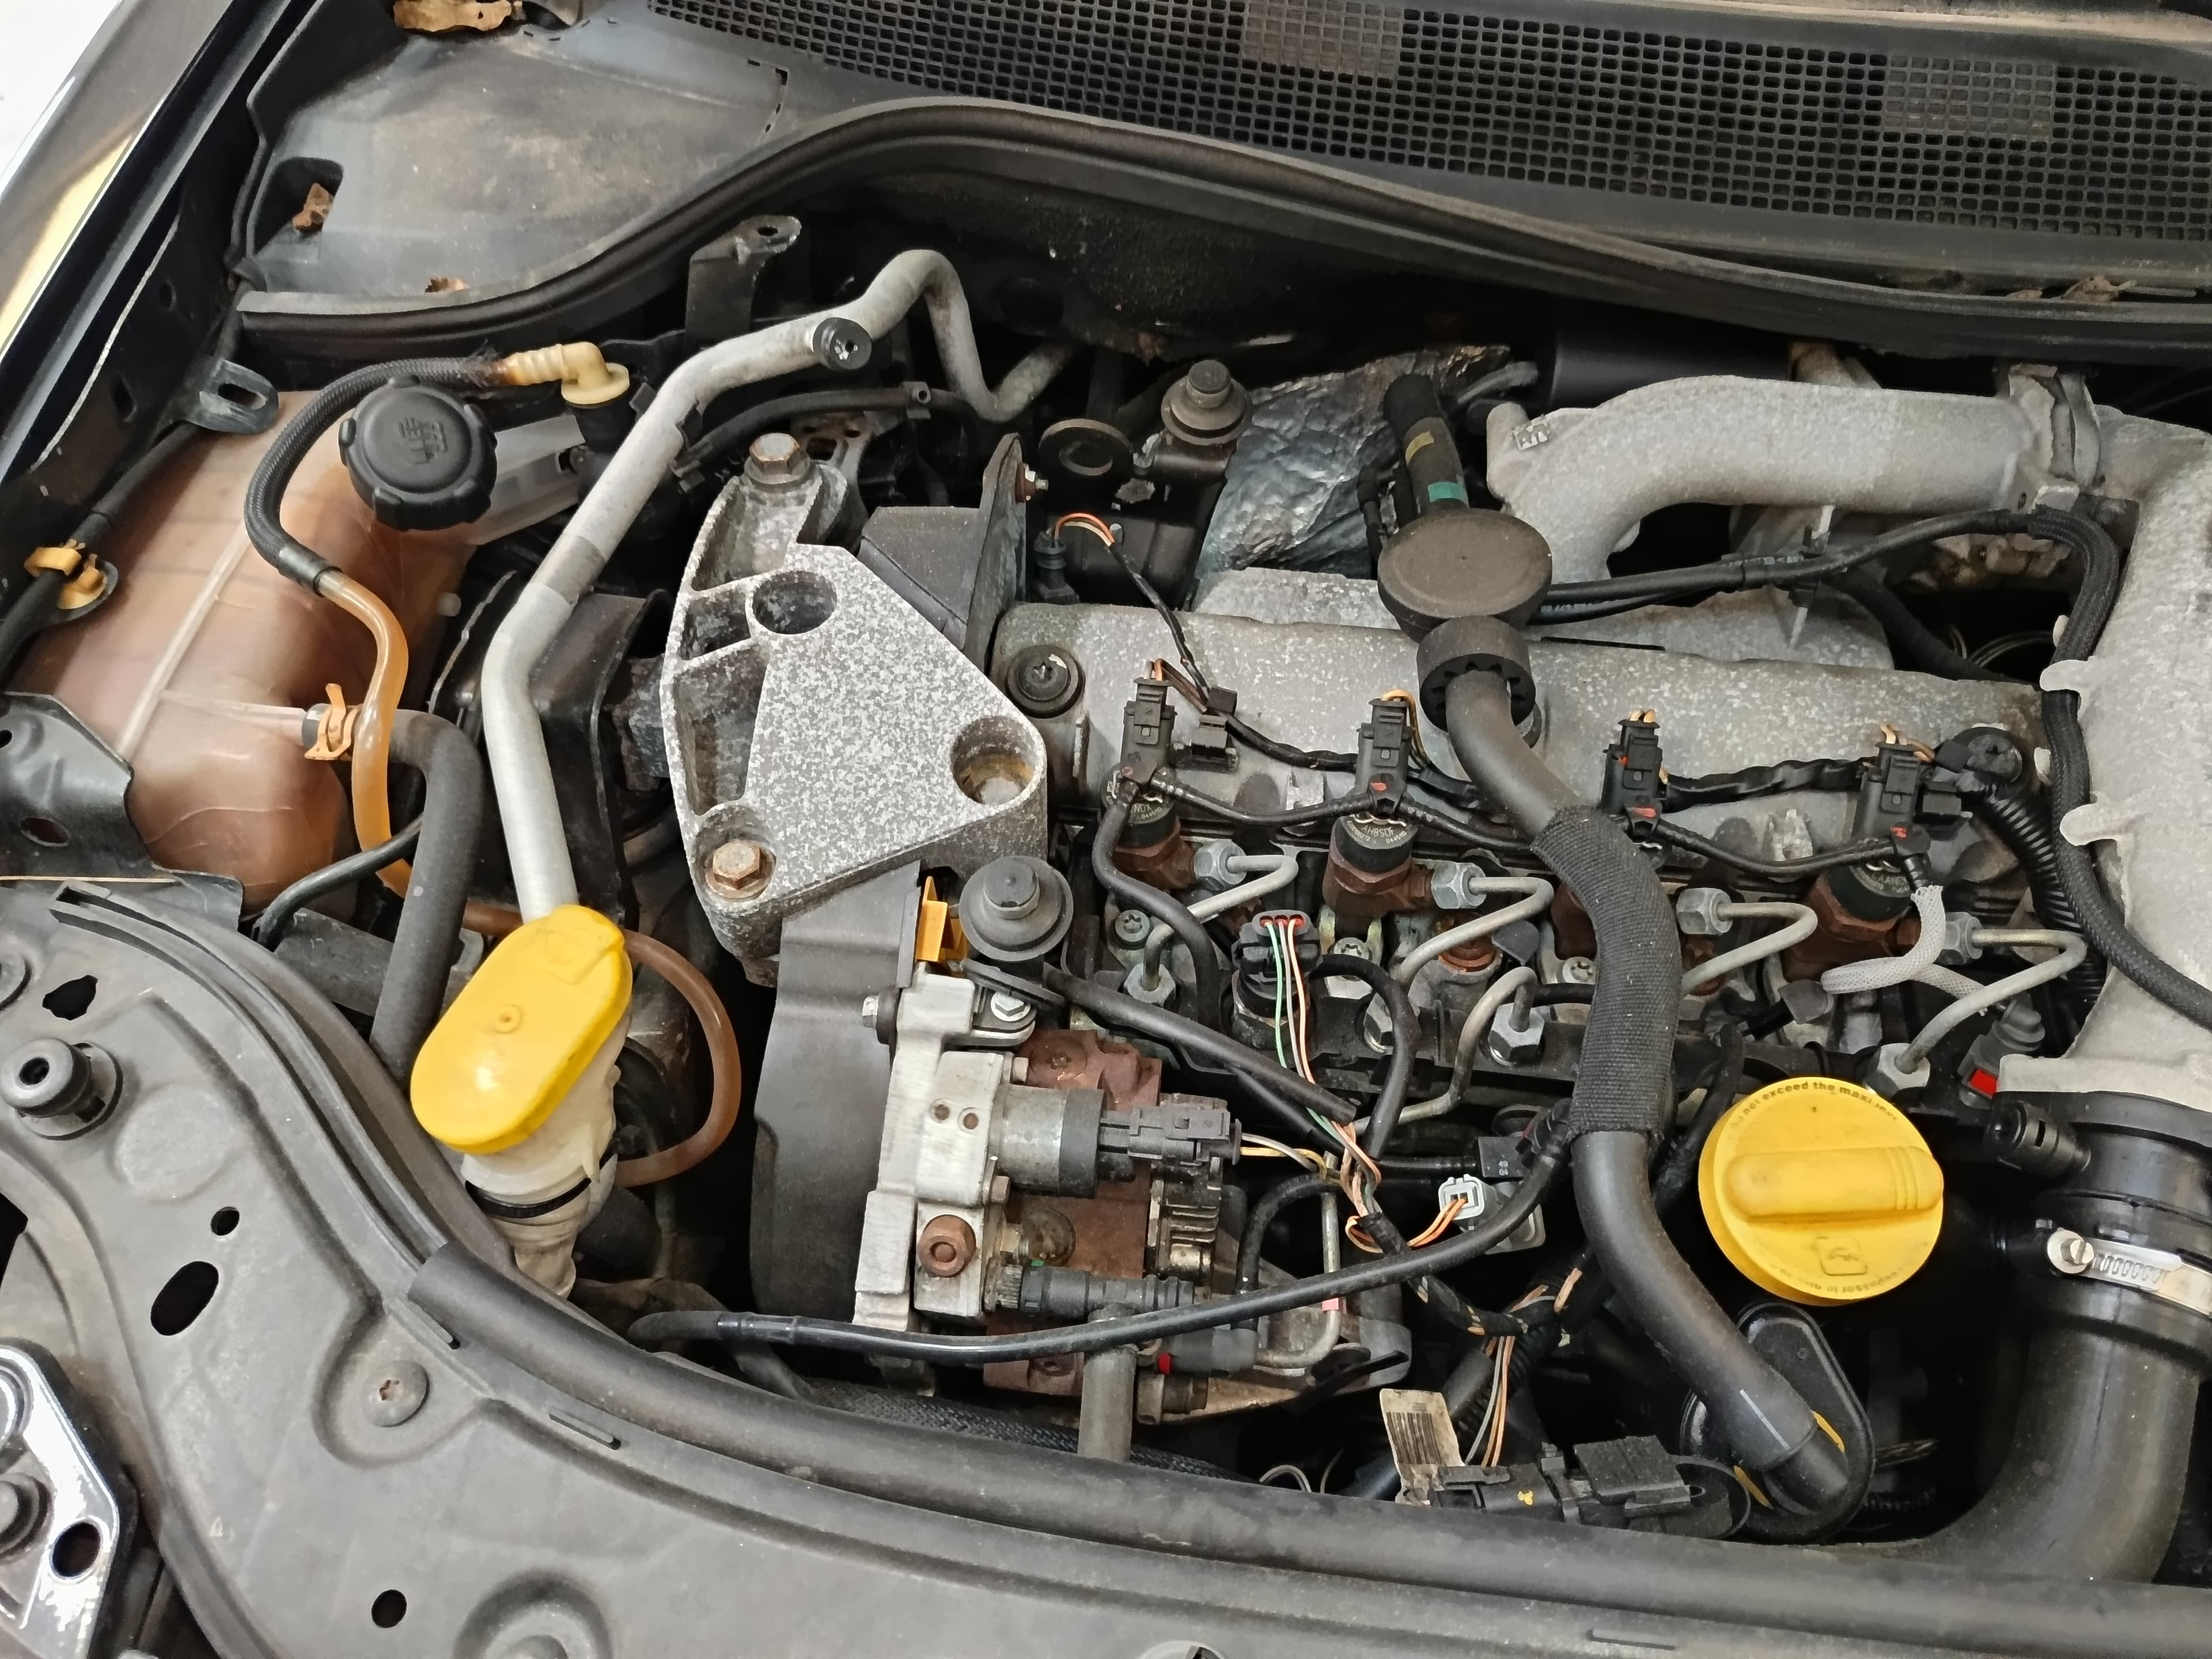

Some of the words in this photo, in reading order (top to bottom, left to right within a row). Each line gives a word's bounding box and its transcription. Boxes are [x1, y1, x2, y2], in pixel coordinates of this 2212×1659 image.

[1743, 1099, 1761, 1115] not
[1762, 1081, 1809, 1100] exceed
[1813, 1081, 1835, 1091] the
[1839, 1086, 1873, 1104] maxi
